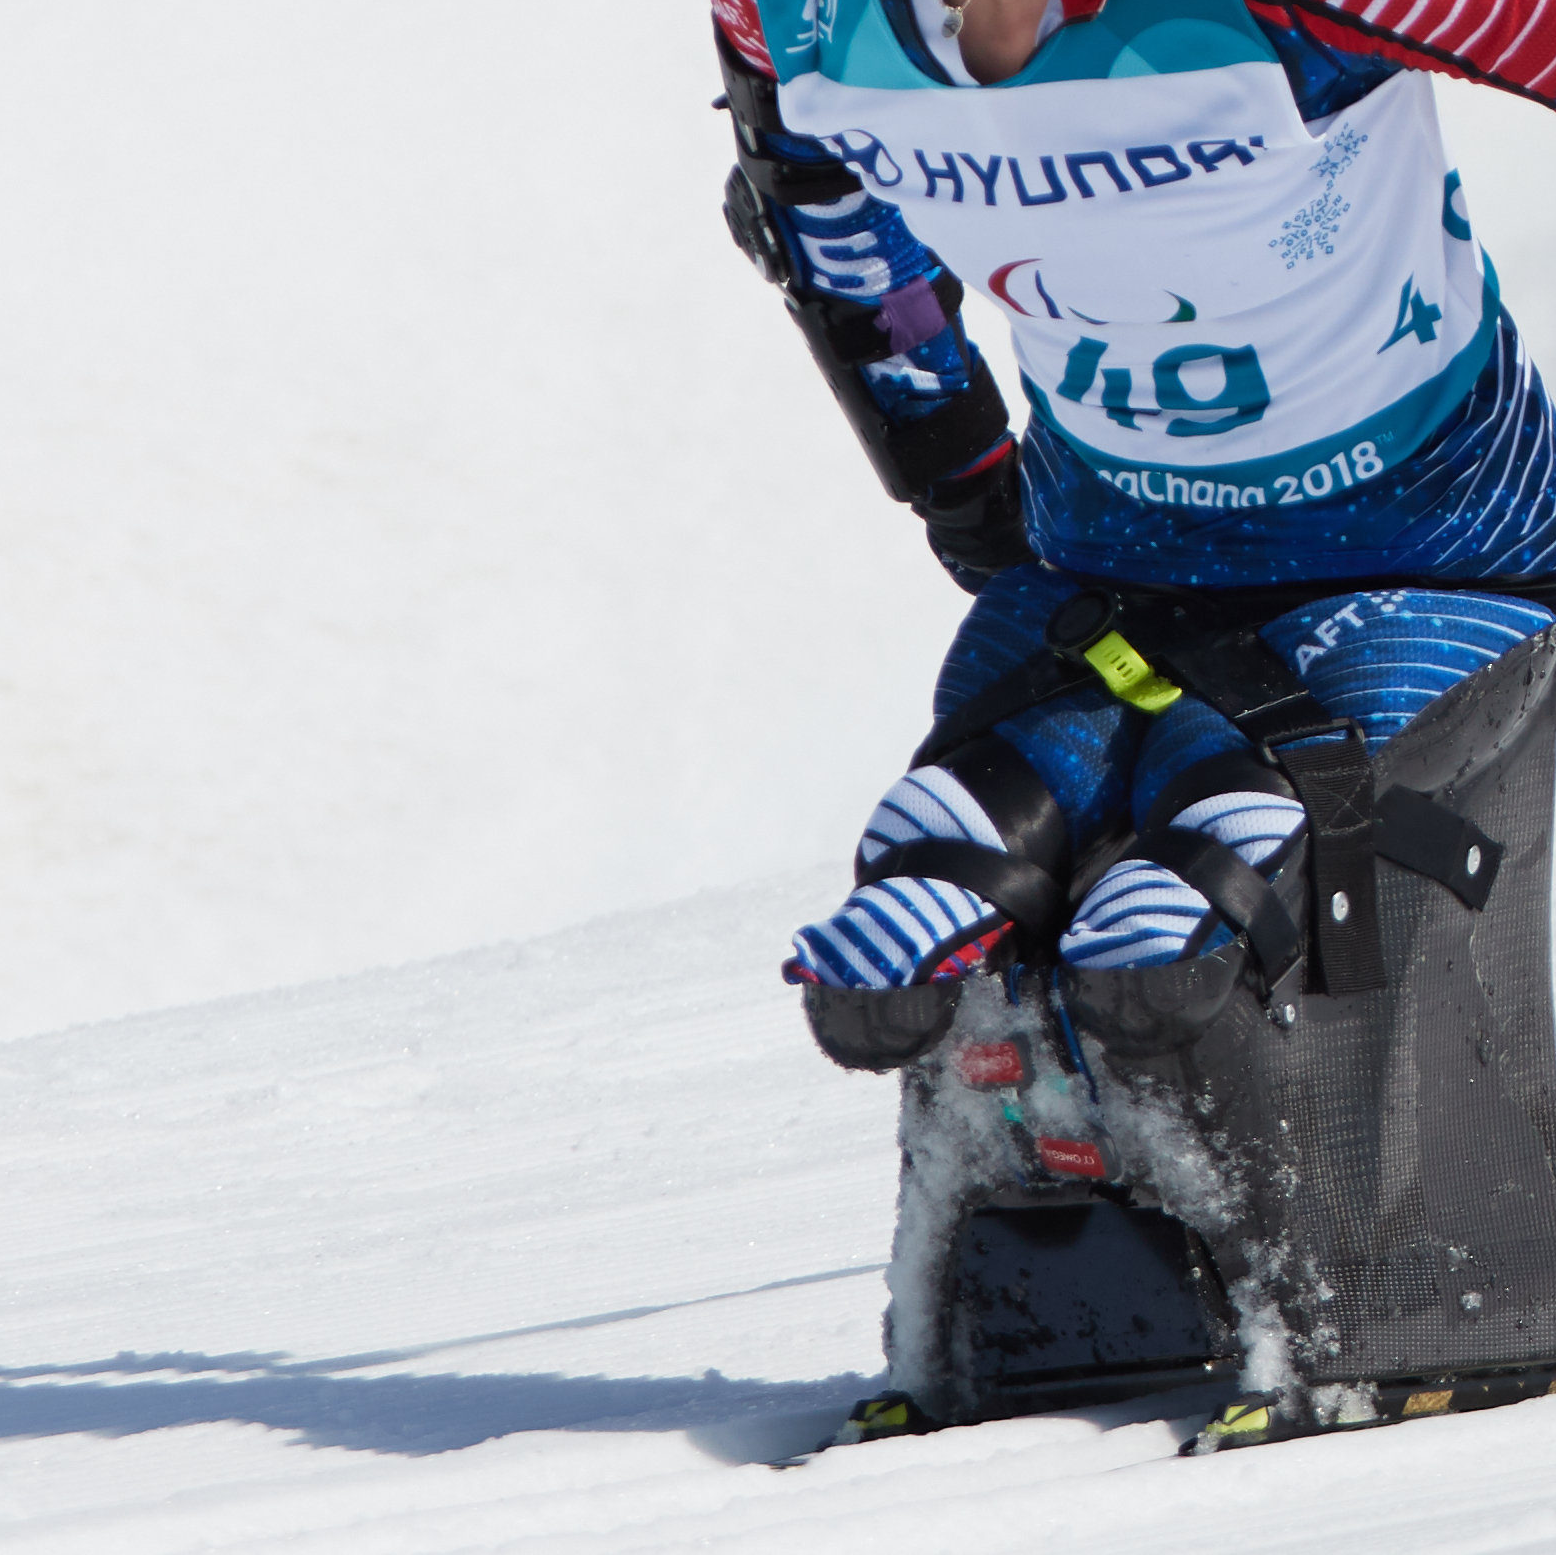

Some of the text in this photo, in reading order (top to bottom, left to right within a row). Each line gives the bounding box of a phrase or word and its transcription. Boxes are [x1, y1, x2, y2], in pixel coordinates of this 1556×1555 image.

[1376, 272, 1443, 356] 4
[1056, 334, 1271, 438] 49
[1294, 601, 1365, 675] AFT
